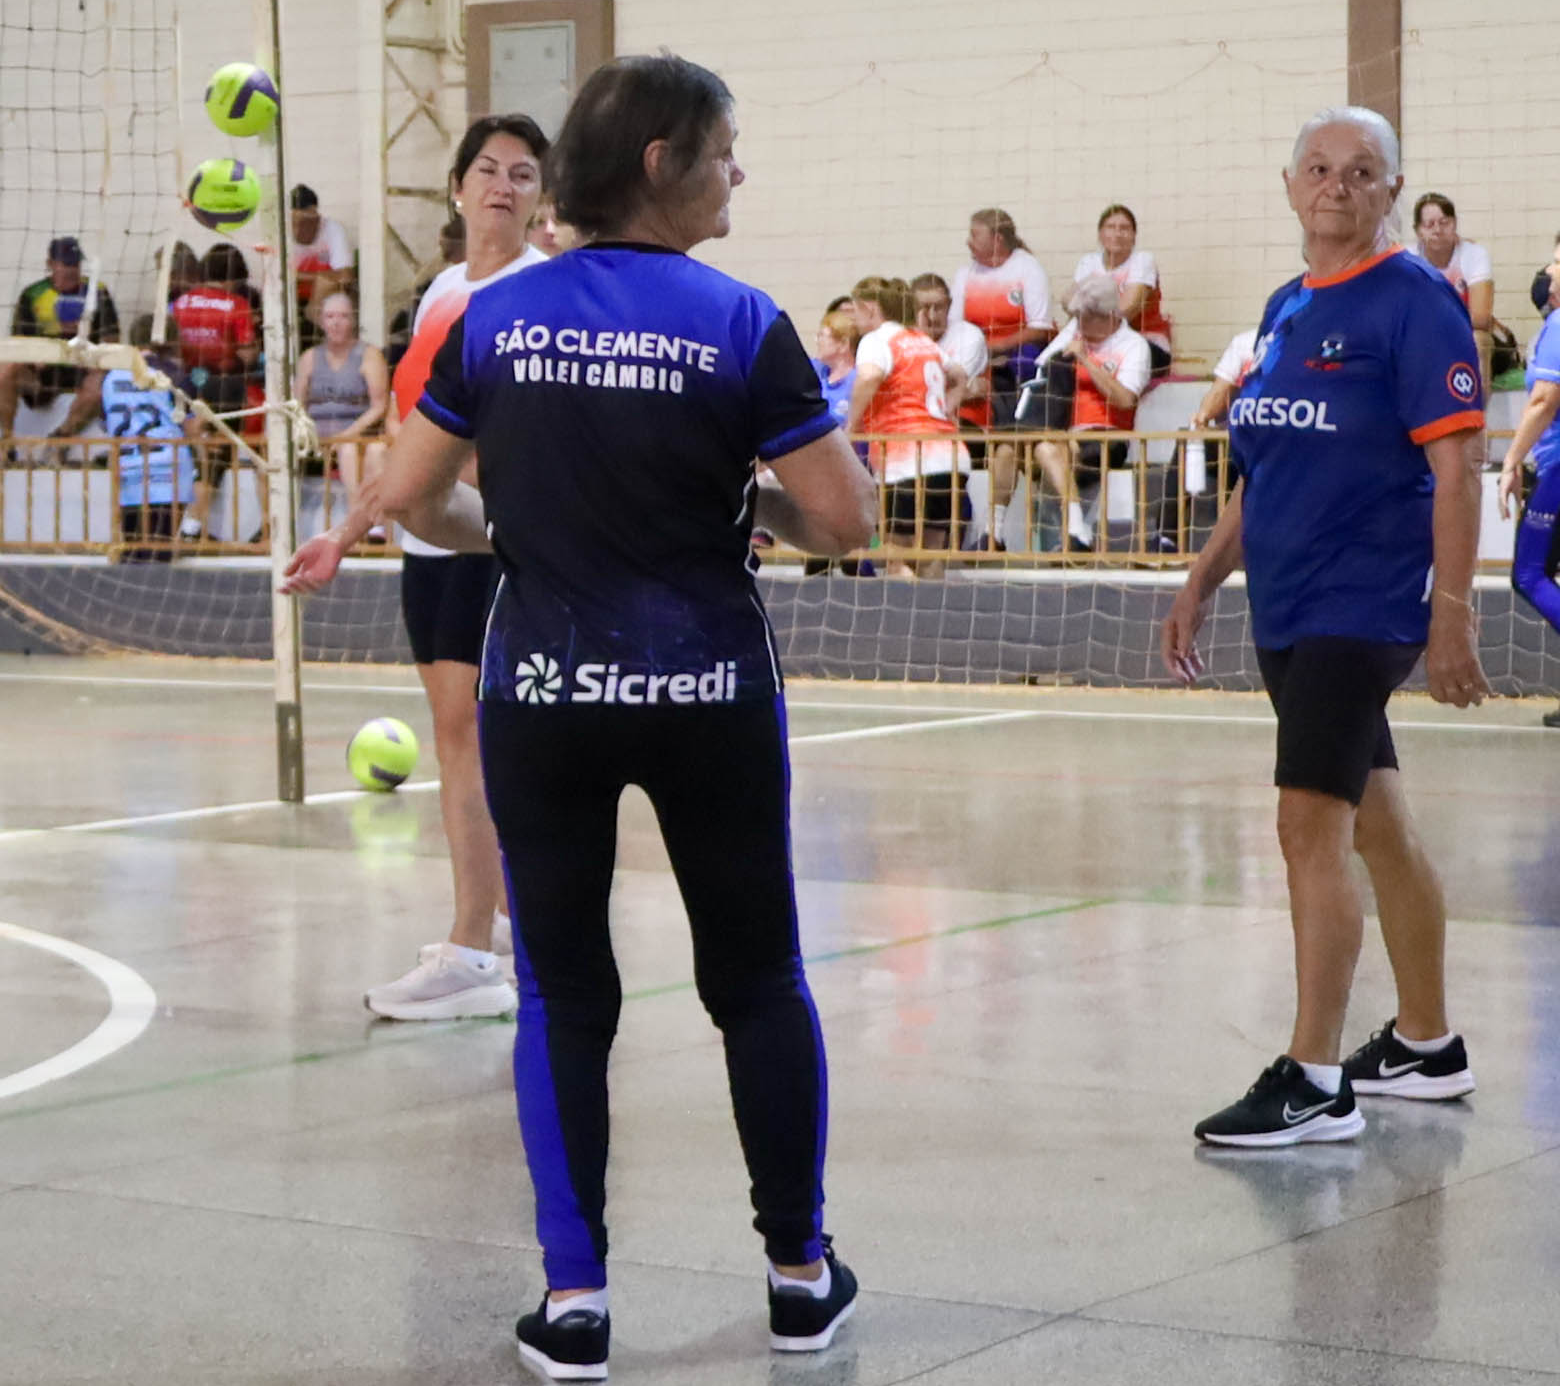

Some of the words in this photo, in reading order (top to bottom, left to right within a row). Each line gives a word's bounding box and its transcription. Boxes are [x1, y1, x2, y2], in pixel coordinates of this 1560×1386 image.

[494, 319, 551, 356] SÃO
[555, 328, 720, 373] CLEMENTE
[513, 353, 579, 385] VÔLEI
[586, 360, 684, 394] CÂMBIO
[1228, 397, 1337, 431] CRESOL
[571, 660, 737, 704] Sicredi
